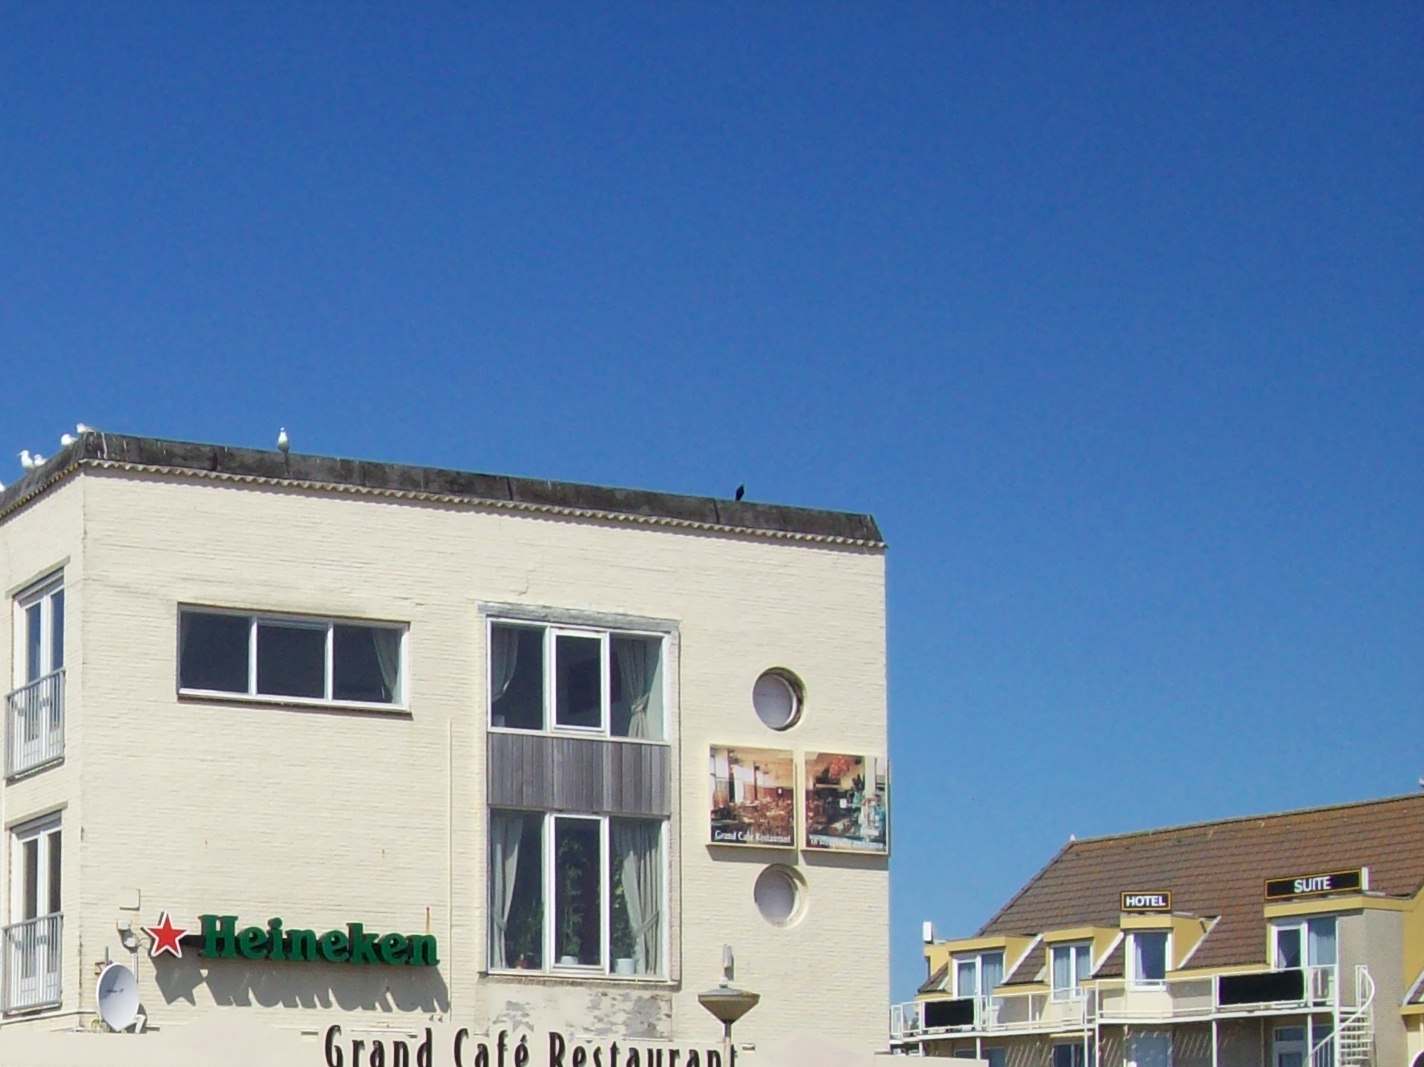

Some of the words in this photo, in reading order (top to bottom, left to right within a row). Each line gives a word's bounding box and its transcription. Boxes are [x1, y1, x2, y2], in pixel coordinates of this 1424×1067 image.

[1294, 876, 1331, 893] SUITE
[1126, 895, 1166, 907] HOTEL
[198, 914, 440, 966] Heineken
